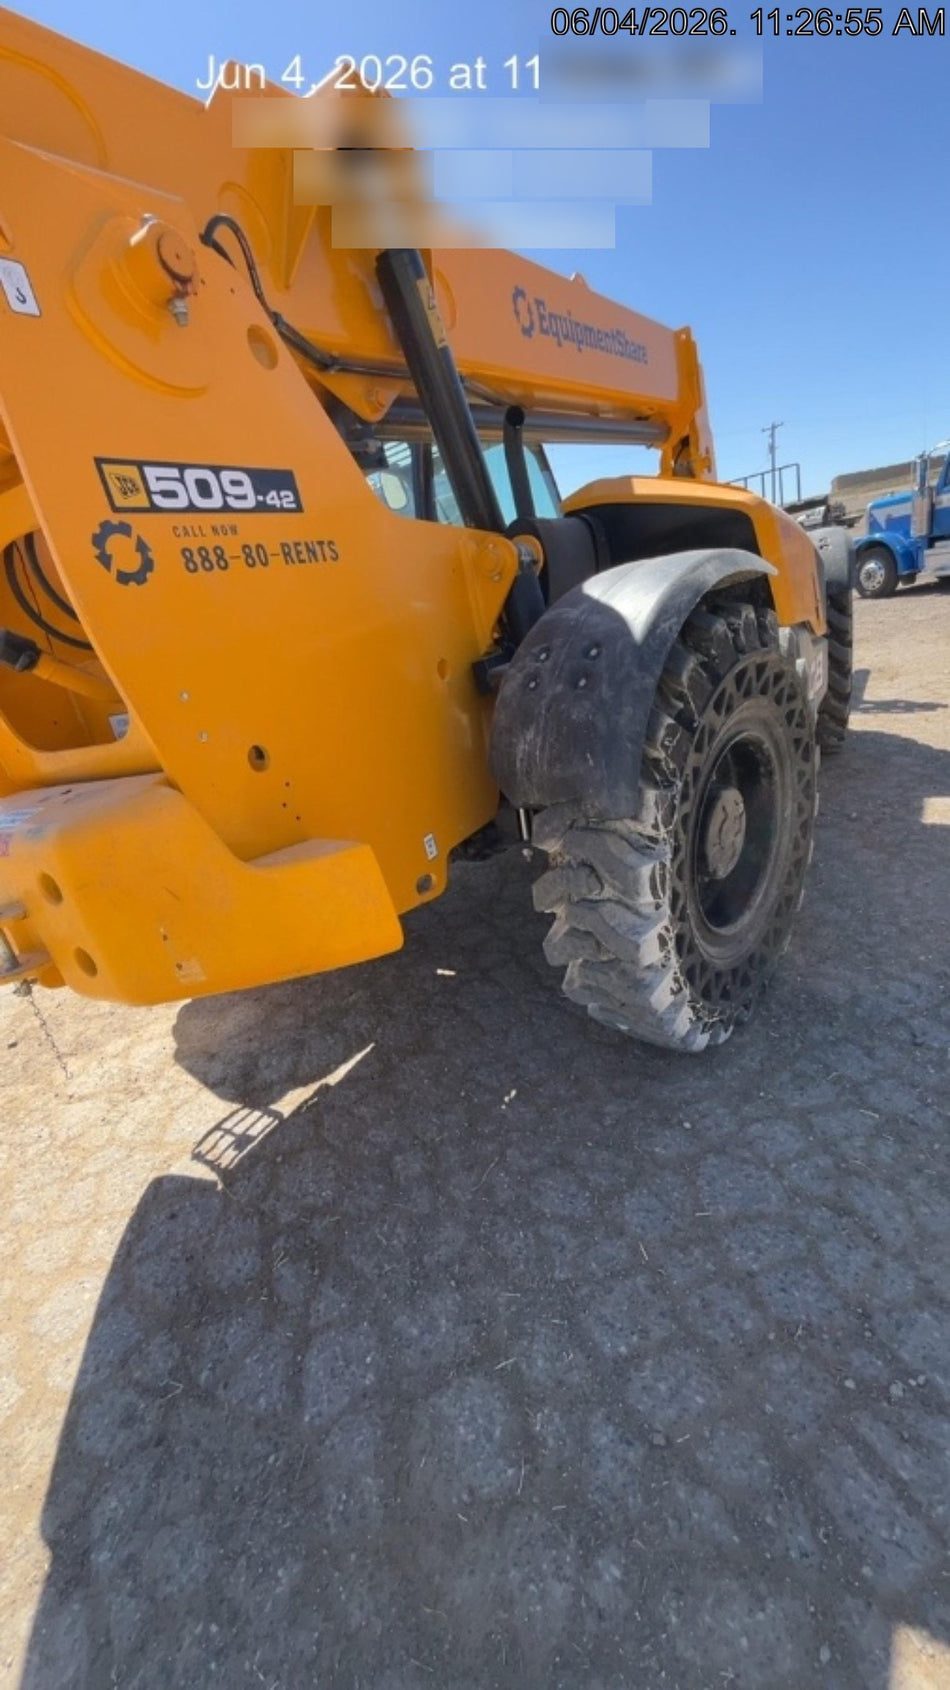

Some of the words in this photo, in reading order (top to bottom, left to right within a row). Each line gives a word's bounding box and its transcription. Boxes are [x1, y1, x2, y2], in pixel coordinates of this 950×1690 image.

[534, 298, 649, 366] EquipmentShare
[142, 465, 297, 509] 509-42
[172, 524, 207, 538] CALL
[212, 523, 239, 537] NOW
[180, 539, 340, 574] 888-80-RENTS
